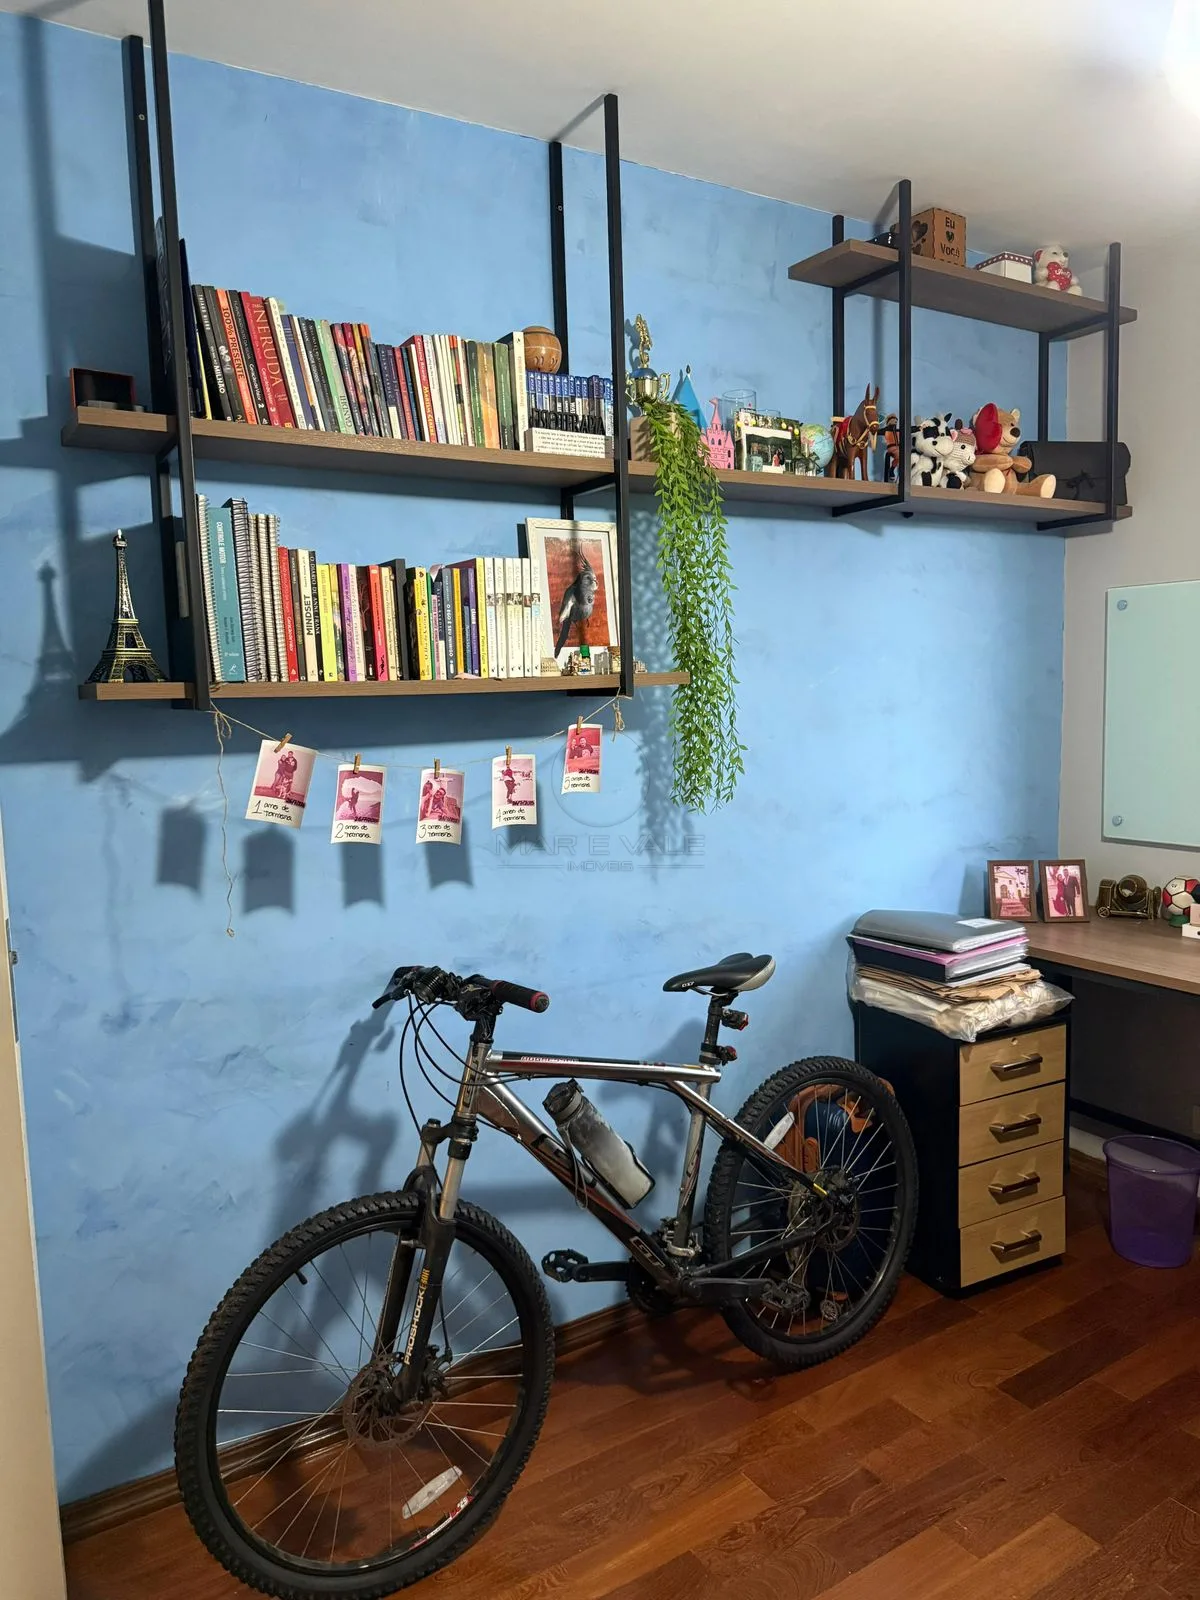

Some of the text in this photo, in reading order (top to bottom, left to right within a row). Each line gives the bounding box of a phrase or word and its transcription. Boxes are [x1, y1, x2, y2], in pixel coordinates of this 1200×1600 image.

[222, 306, 245, 380] 100% PRESENTE
[253, 309, 284, 387] NERUDA
[339, 394, 353, 428] GANDHI
[215, 521, 225, 546] CONTROLE
[218, 546, 227, 564] MOTOR
[311, 586, 318, 595] DE
[303, 594, 314, 636] MINDSET
[251, 800, 263, 815] 1
[335, 822, 344, 839] 2
[418, 824, 427, 839] 3
[403, 1288, 426, 1365] PROSHOCK
